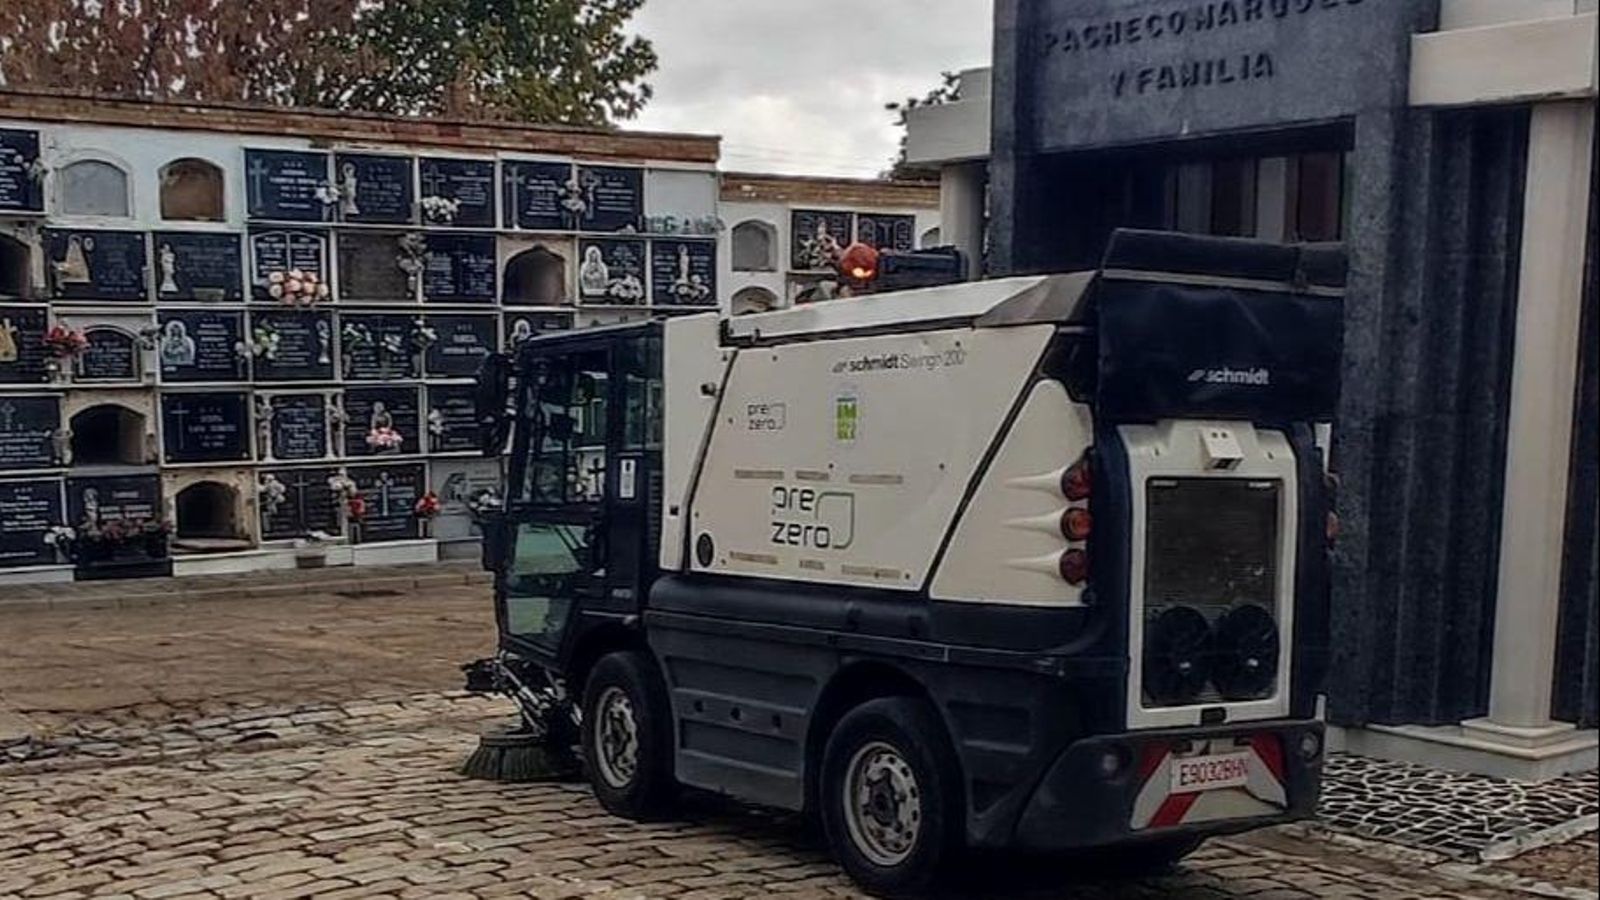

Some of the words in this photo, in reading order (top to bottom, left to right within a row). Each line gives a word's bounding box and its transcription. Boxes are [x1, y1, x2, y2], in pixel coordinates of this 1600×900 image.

[1041, 10, 1186, 57] PACHECO
[1195, 0, 1363, 32] MARQU
[1110, 72, 1126, 98] Y
[1137, 52, 1275, 94] FAMILIA
[849, 354, 899, 372] schmidt
[1205, 367, 1270, 385] schmidt
[747, 404, 770, 416] pre
[748, 418, 776, 430] zero
[772, 486, 815, 516] pre
[772, 521, 831, 549] zero
